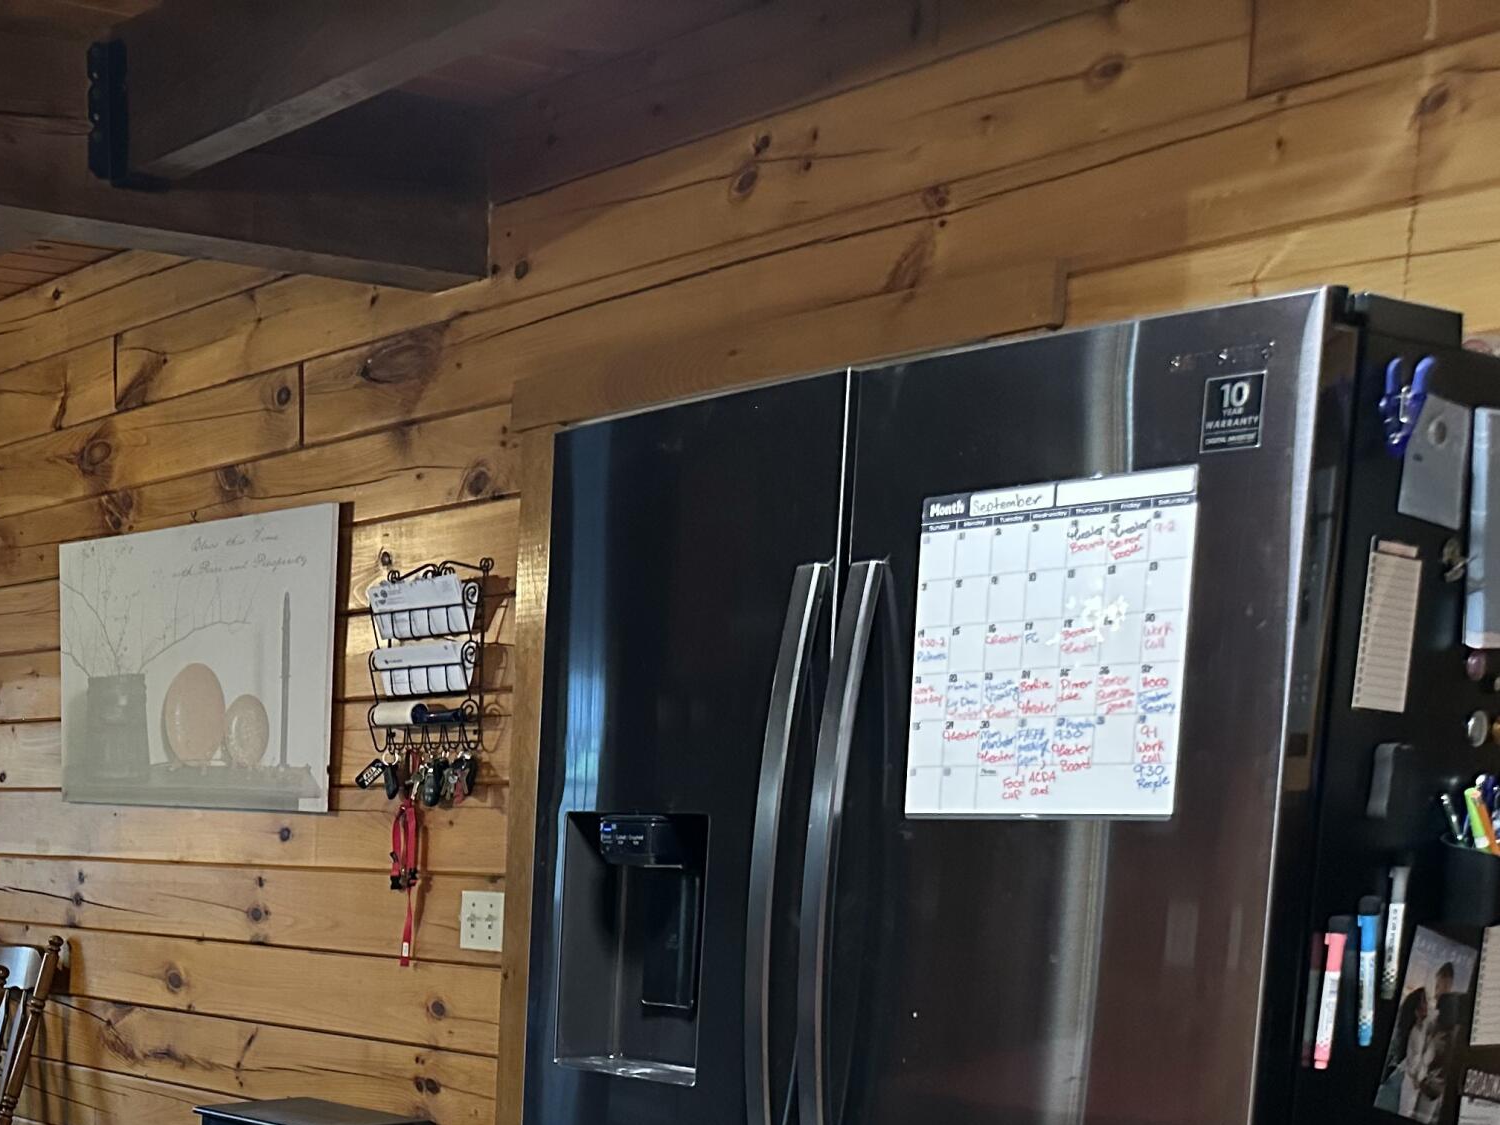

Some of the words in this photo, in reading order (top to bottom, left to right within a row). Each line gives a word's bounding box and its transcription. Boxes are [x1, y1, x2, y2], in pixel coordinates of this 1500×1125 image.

[1220, 381, 1250, 408] 10
[1222, 407, 1244, 417] YEAR
[1205, 416, 1259, 430] WARRANTY
[929, 499, 966, 518] Month
[972, 494, 1043, 515] September
[1075, 506, 1105, 515] Thursday
[1120, 502, 1141, 511] Friday
[963, 520, 987, 528] Monday
[999, 515, 1025, 523] Tuesday
[928, 524, 950, 532] Sunday
[250, 552, 307, 573] Prosperity
[952, 626, 961, 636] 15
[988, 623, 997, 633] 16
[980, 720, 990, 729] 30
[1060, 757, 1092, 772] Board
[1003, 775, 1025, 788] Food
